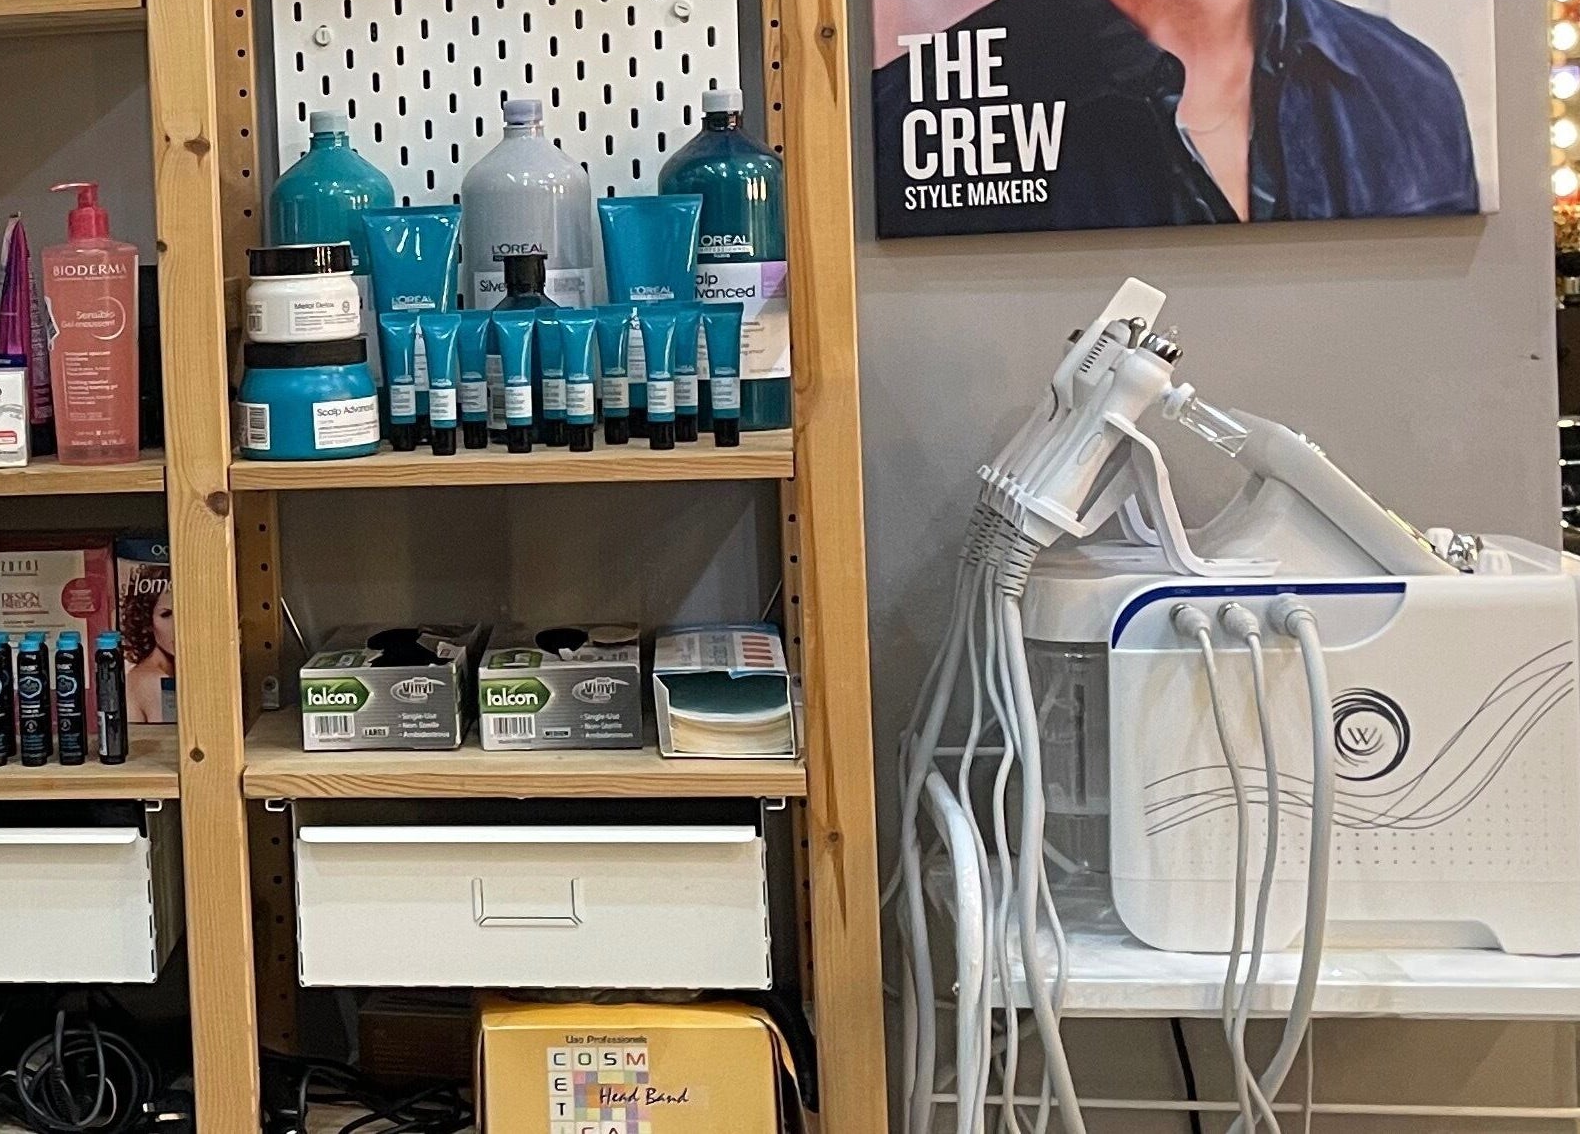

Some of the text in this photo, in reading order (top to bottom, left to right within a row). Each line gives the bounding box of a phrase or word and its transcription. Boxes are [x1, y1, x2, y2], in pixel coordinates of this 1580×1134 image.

[897, 27, 1009, 103] THE
[902, 100, 1066, 180] CREW
[905, 178, 1048, 210] STYLE MAKERS
[52, 264, 127, 277] BIODERMA
[317, 407, 342, 418] Scalp
[1, 592, 40, 602] DESIGN
[307, 681, 434, 705] falcon Vinyl
[486, 681, 616, 706] falcon Vinyl
[599, 1087, 690, 1106] Head Band
